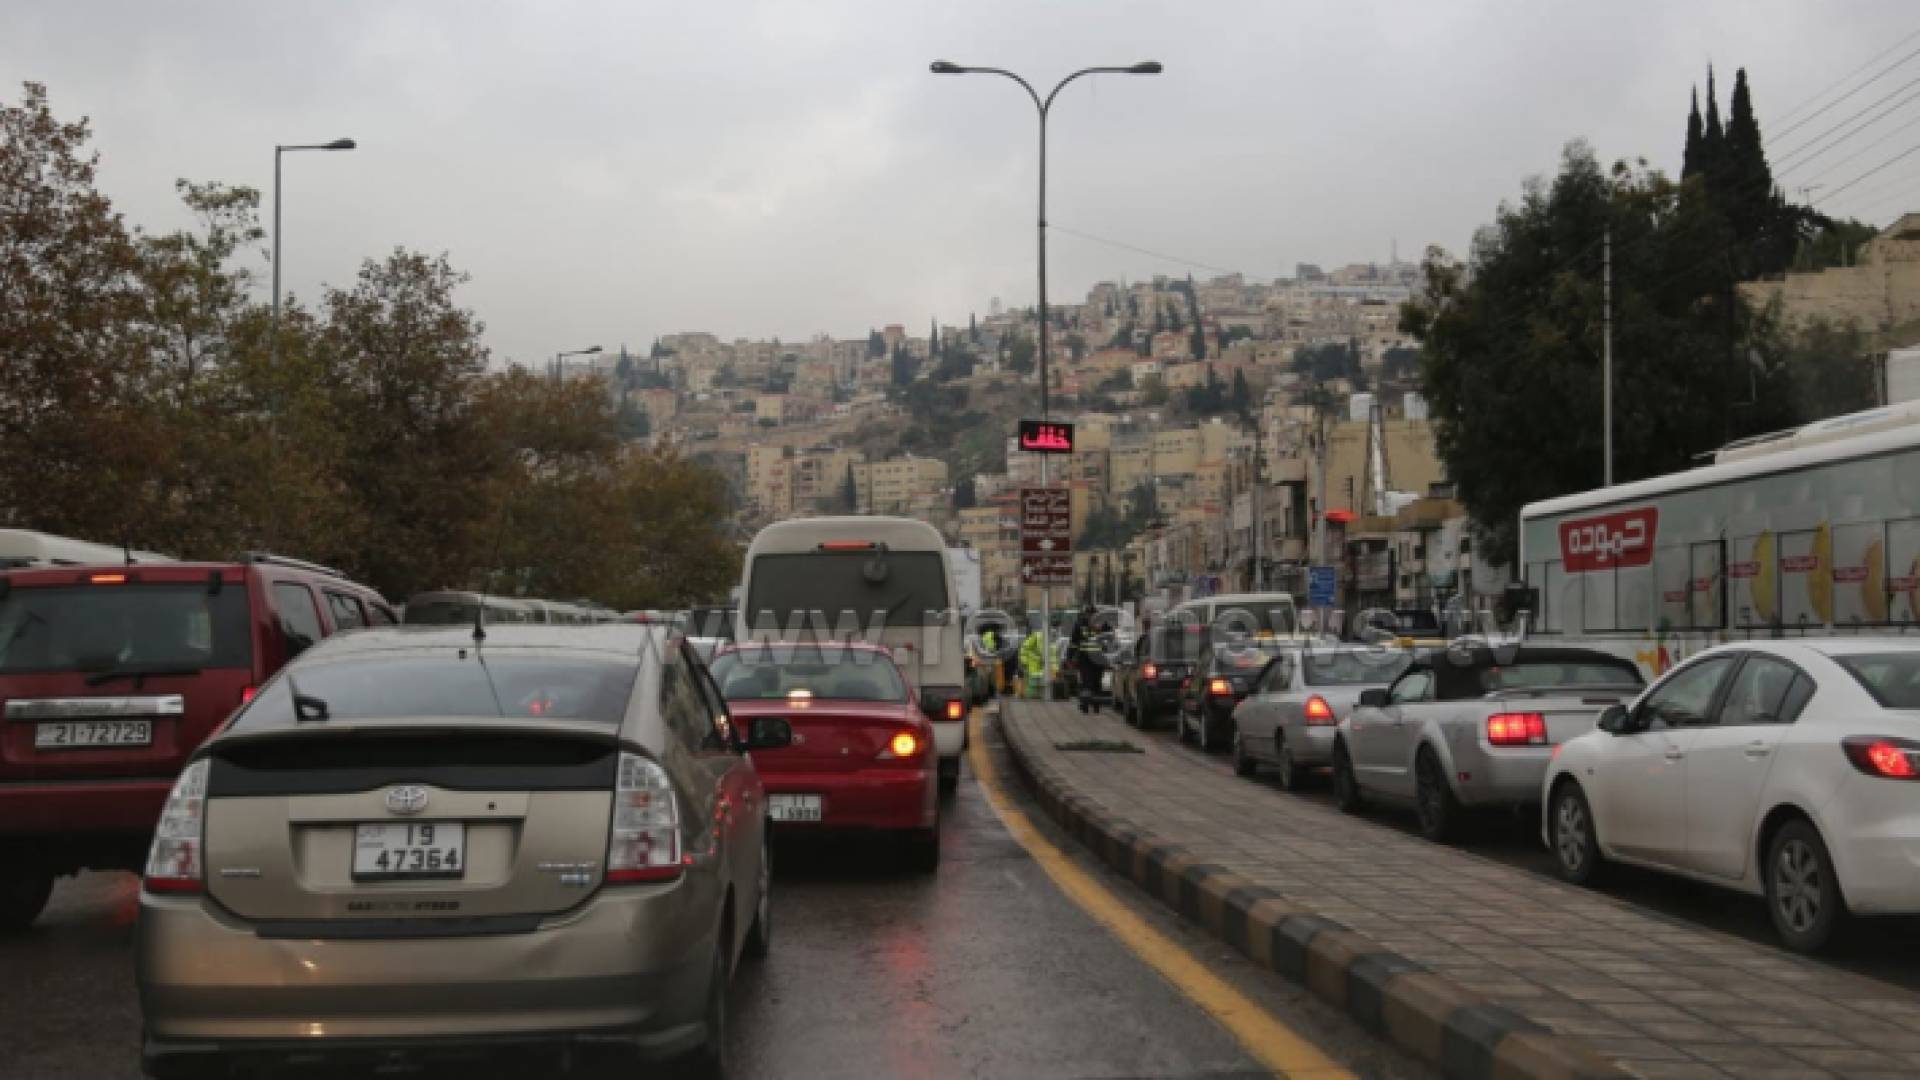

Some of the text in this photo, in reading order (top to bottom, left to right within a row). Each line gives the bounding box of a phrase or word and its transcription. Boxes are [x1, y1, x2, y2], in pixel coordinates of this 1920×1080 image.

[1568, 517, 1646, 562] حموده
[54, 723, 147, 743] 21-72729
[407, 824, 435, 846] 19
[375, 847, 458, 872] 47364
